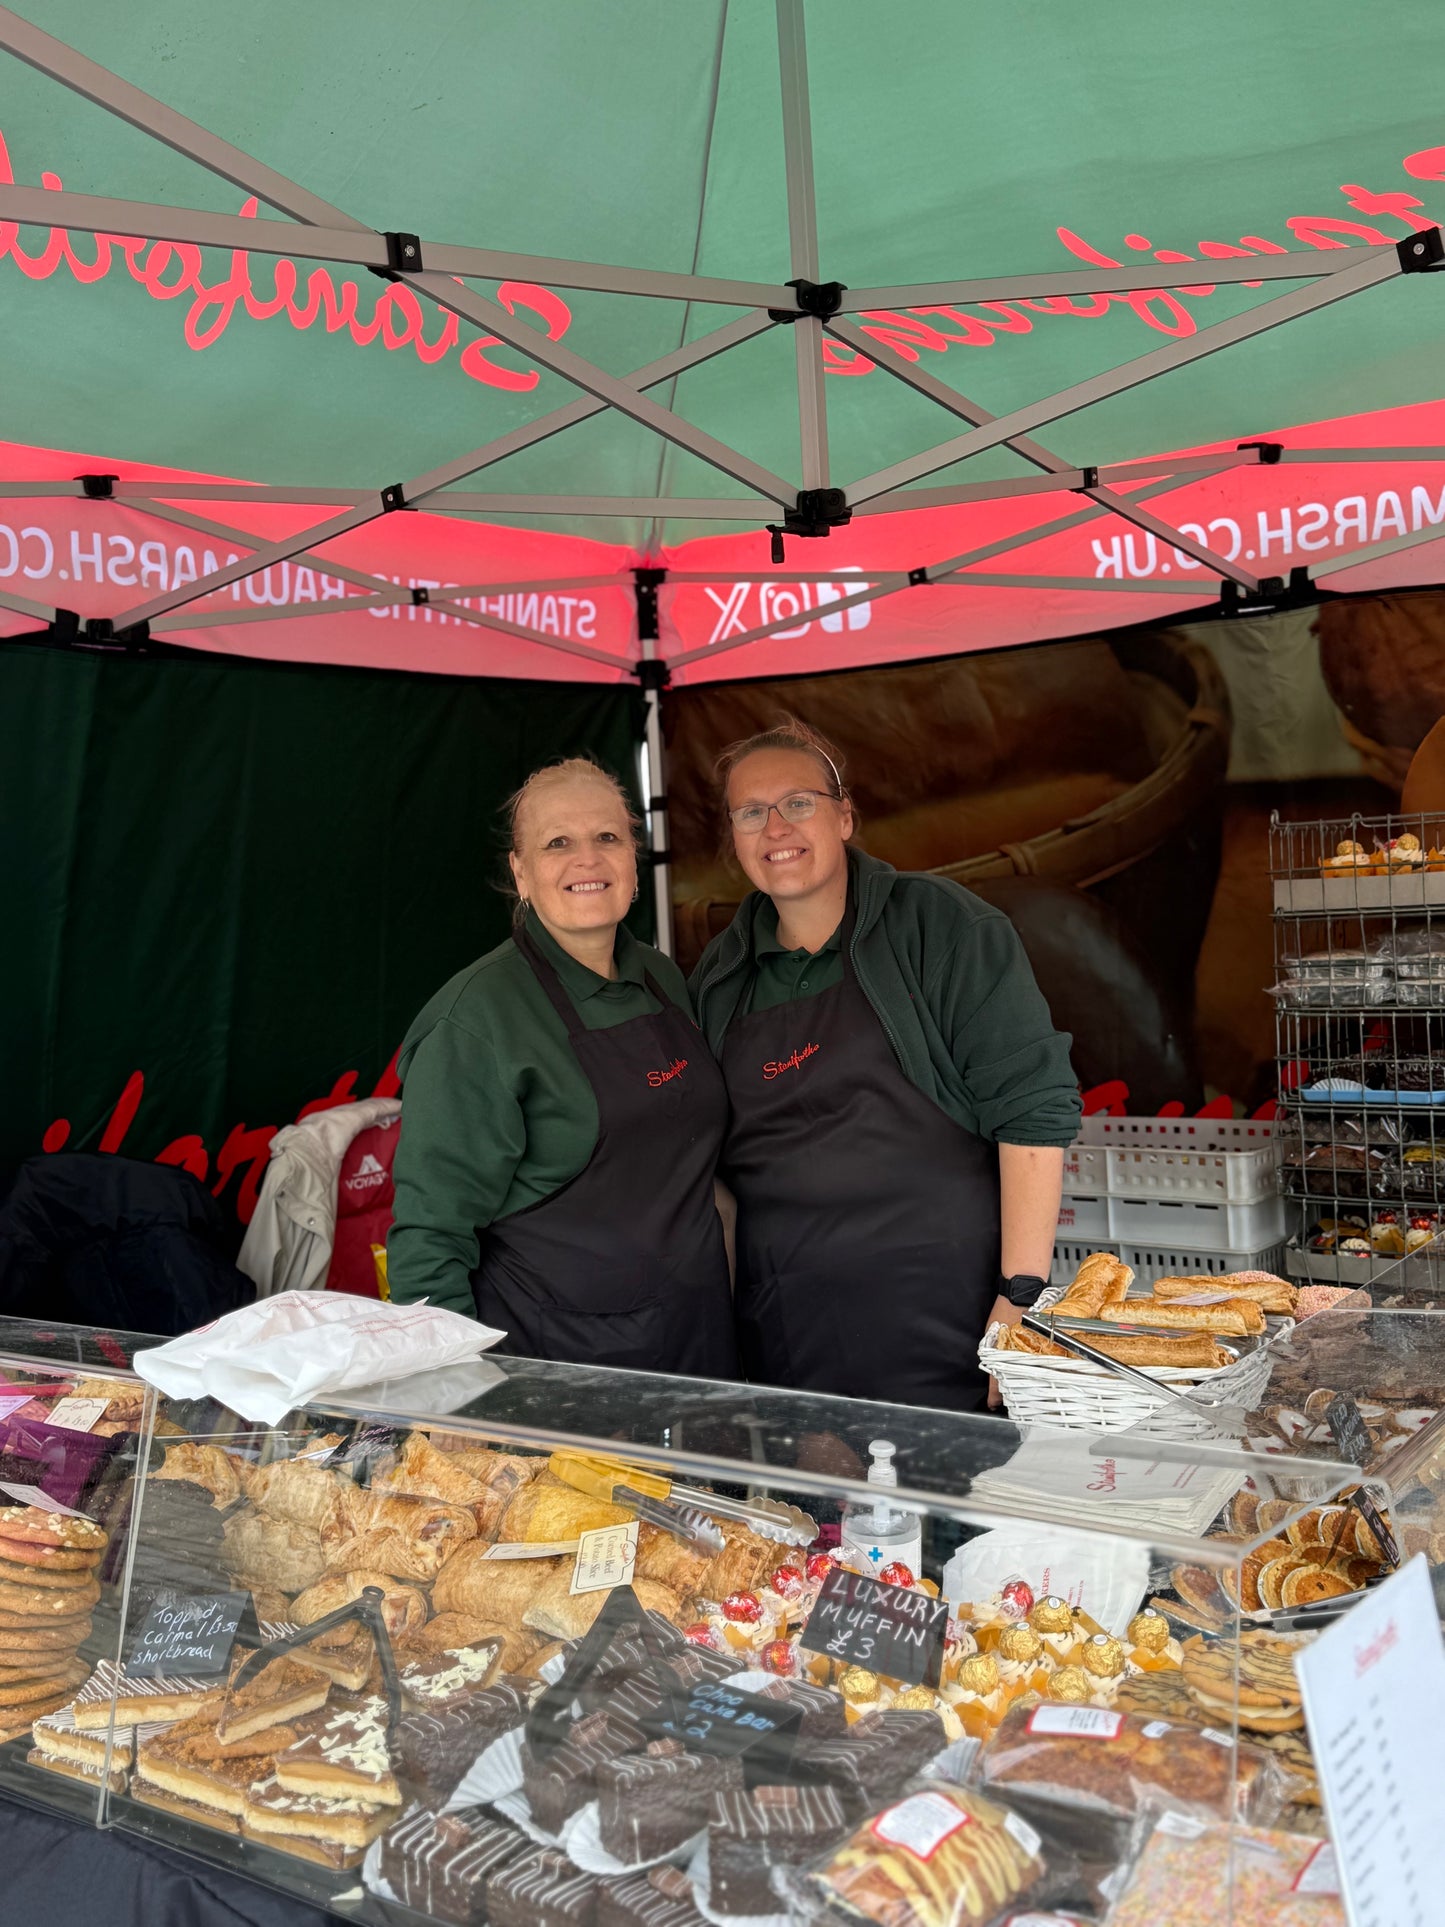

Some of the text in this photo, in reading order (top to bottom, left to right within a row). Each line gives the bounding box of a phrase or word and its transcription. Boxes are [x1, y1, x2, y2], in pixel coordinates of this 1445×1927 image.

[831, 1574, 947, 1624] LUXURY
[1041, 1567, 1050, 1595] KERS
[153, 1602, 218, 1632] Toppd
[820, 1602, 926, 1647] MUFFIN
